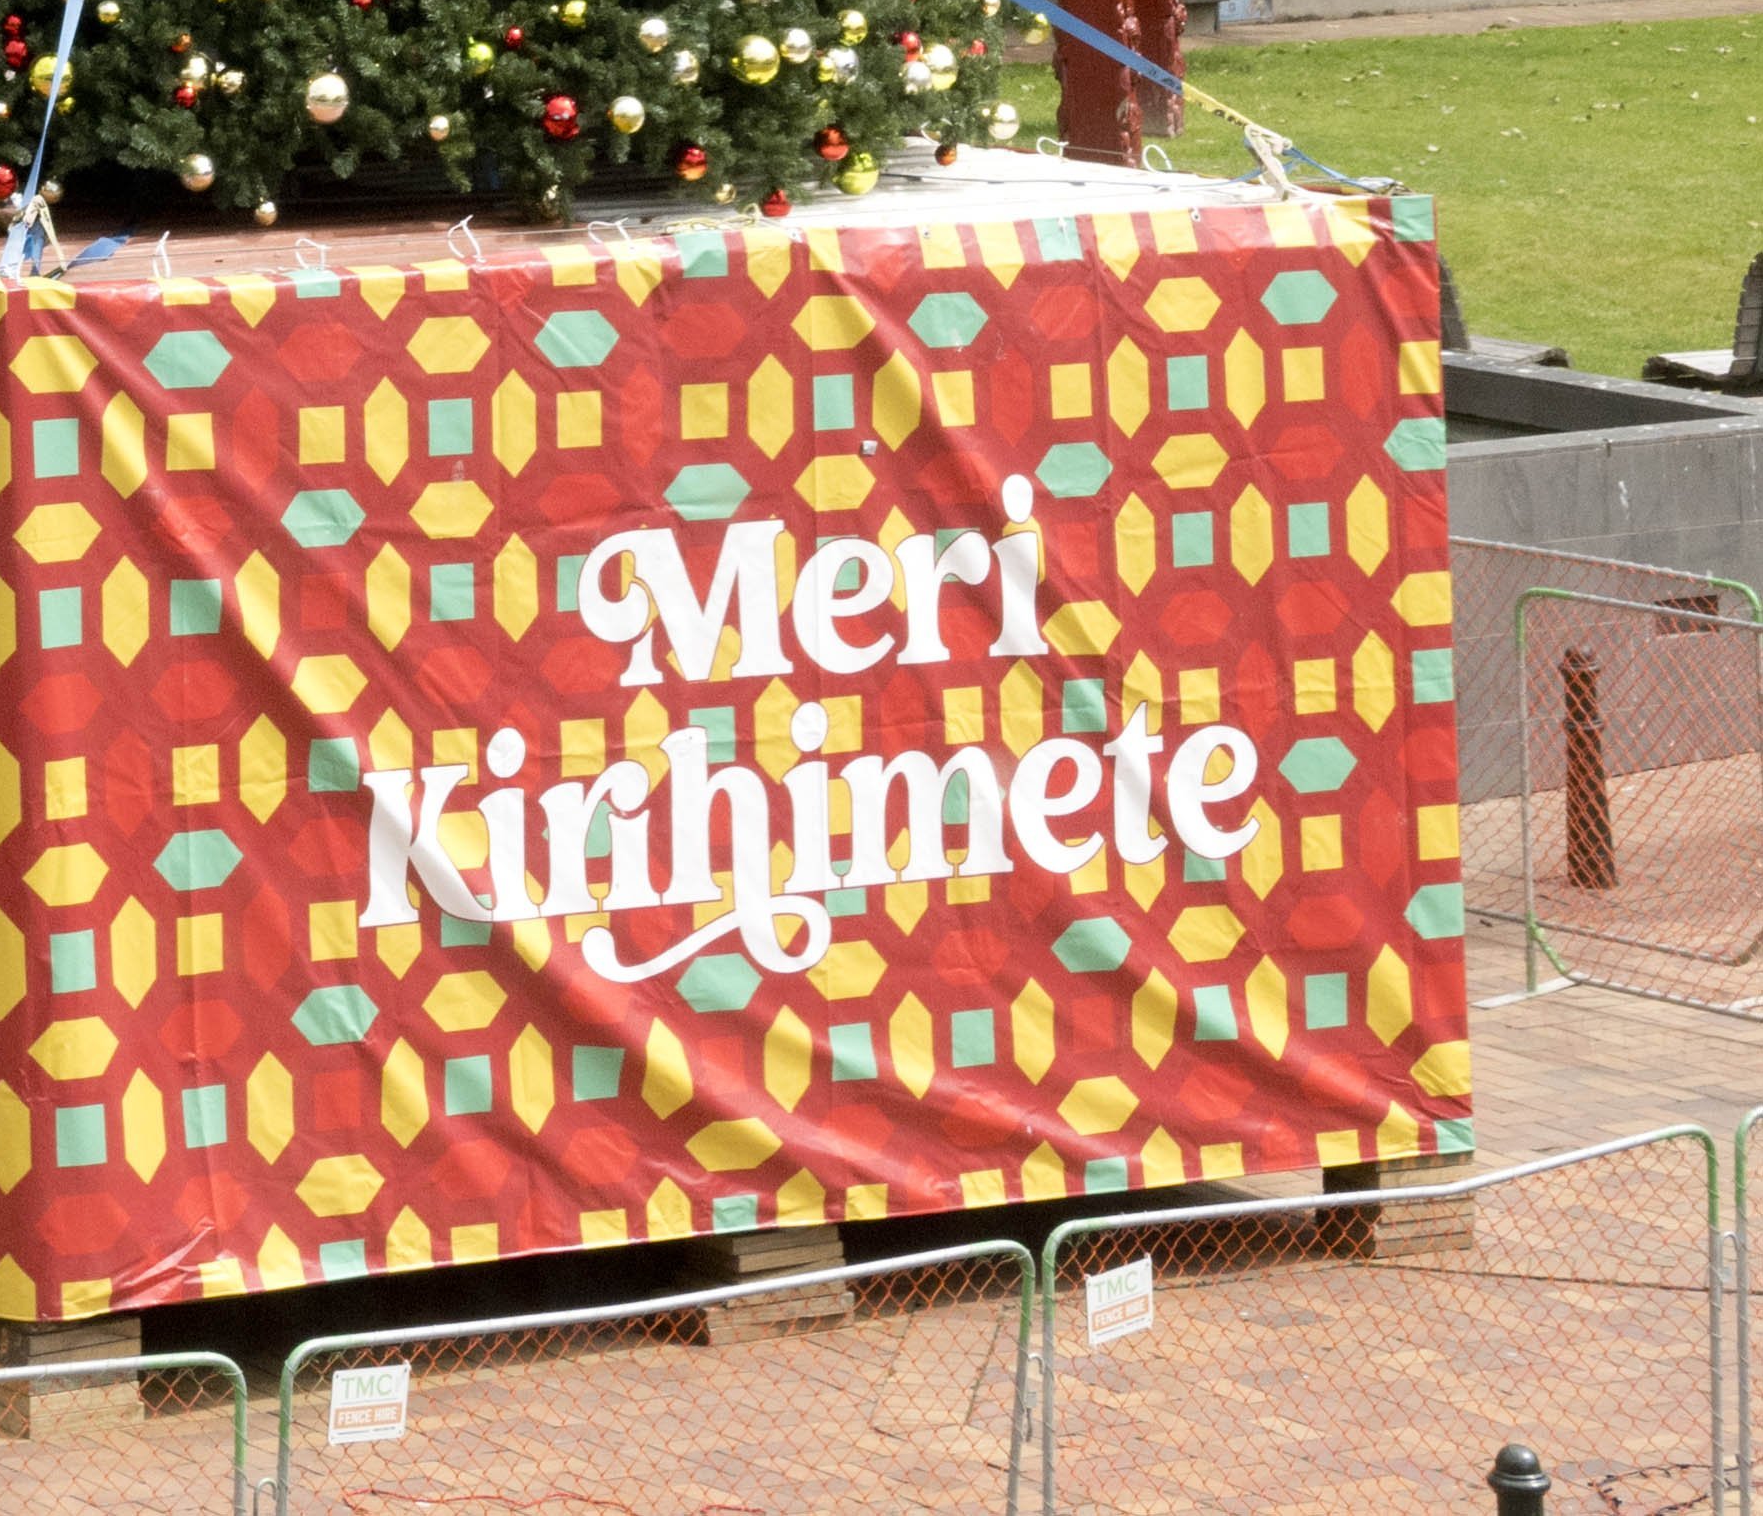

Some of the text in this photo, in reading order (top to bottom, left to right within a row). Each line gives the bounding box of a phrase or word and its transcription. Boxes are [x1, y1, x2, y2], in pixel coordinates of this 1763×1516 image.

[576, 472, 1049, 689] Meri
[358, 700, 1262, 985] Kirihimete
[1093, 1269, 1138, 1304] TMC
[341, 1373, 393, 1399] TMC
[338, 1406, 397, 1425] FENCE HIRE
